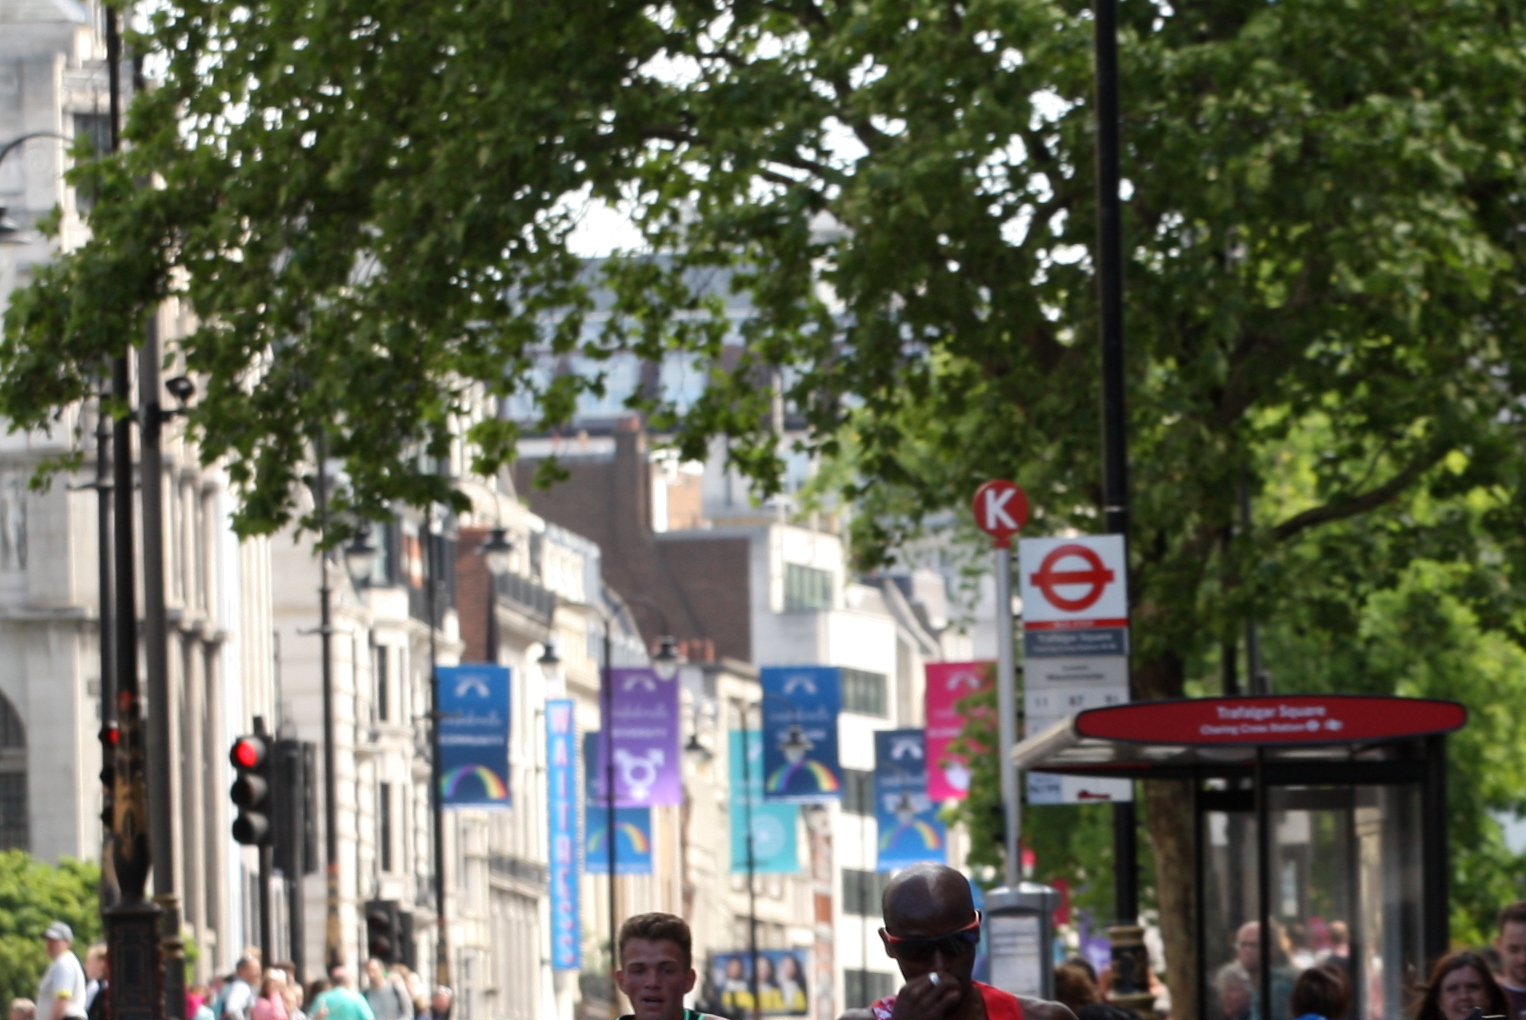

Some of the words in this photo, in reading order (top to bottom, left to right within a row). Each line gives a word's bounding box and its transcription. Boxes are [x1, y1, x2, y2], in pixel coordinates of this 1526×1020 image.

[985, 488, 1019, 531] K
[1217, 705, 1275, 721] Trafalgar
[1279, 704, 1326, 719] Square
